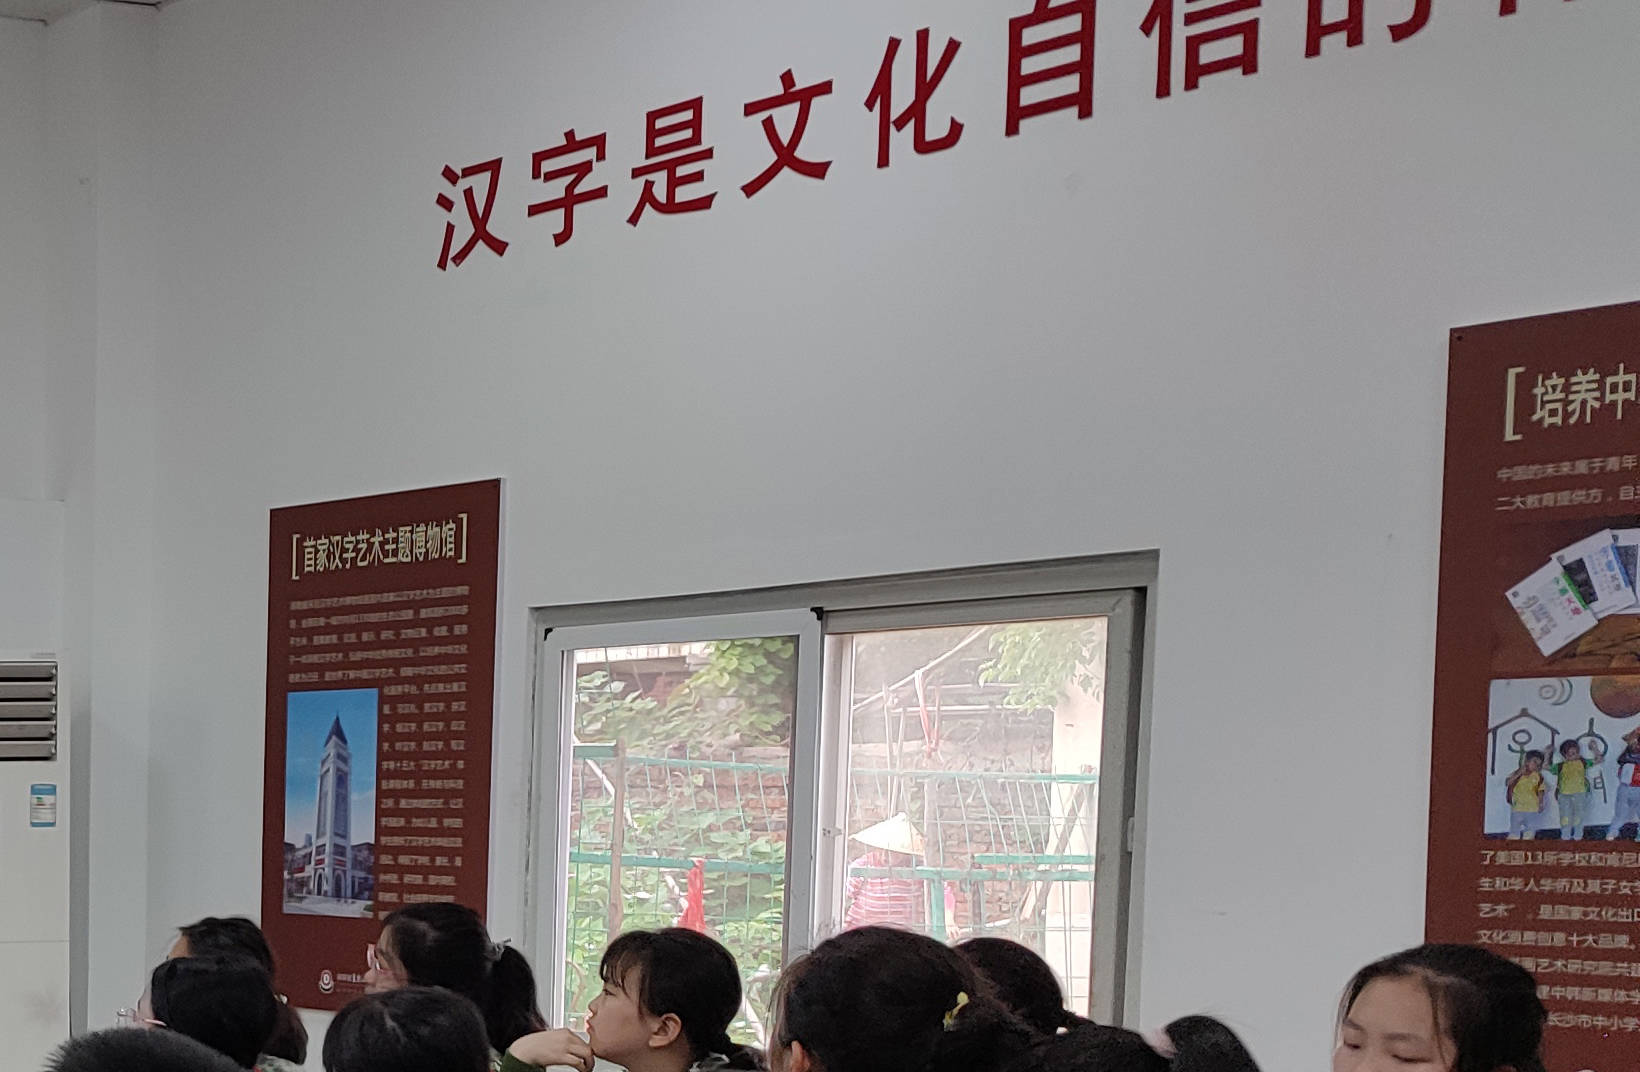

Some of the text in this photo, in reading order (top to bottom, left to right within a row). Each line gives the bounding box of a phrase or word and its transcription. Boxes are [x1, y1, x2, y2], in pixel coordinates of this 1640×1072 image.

[435, 0, 1576, 271] 汉字是文化自信
[1504, 363, 1640, 441] [培养中
